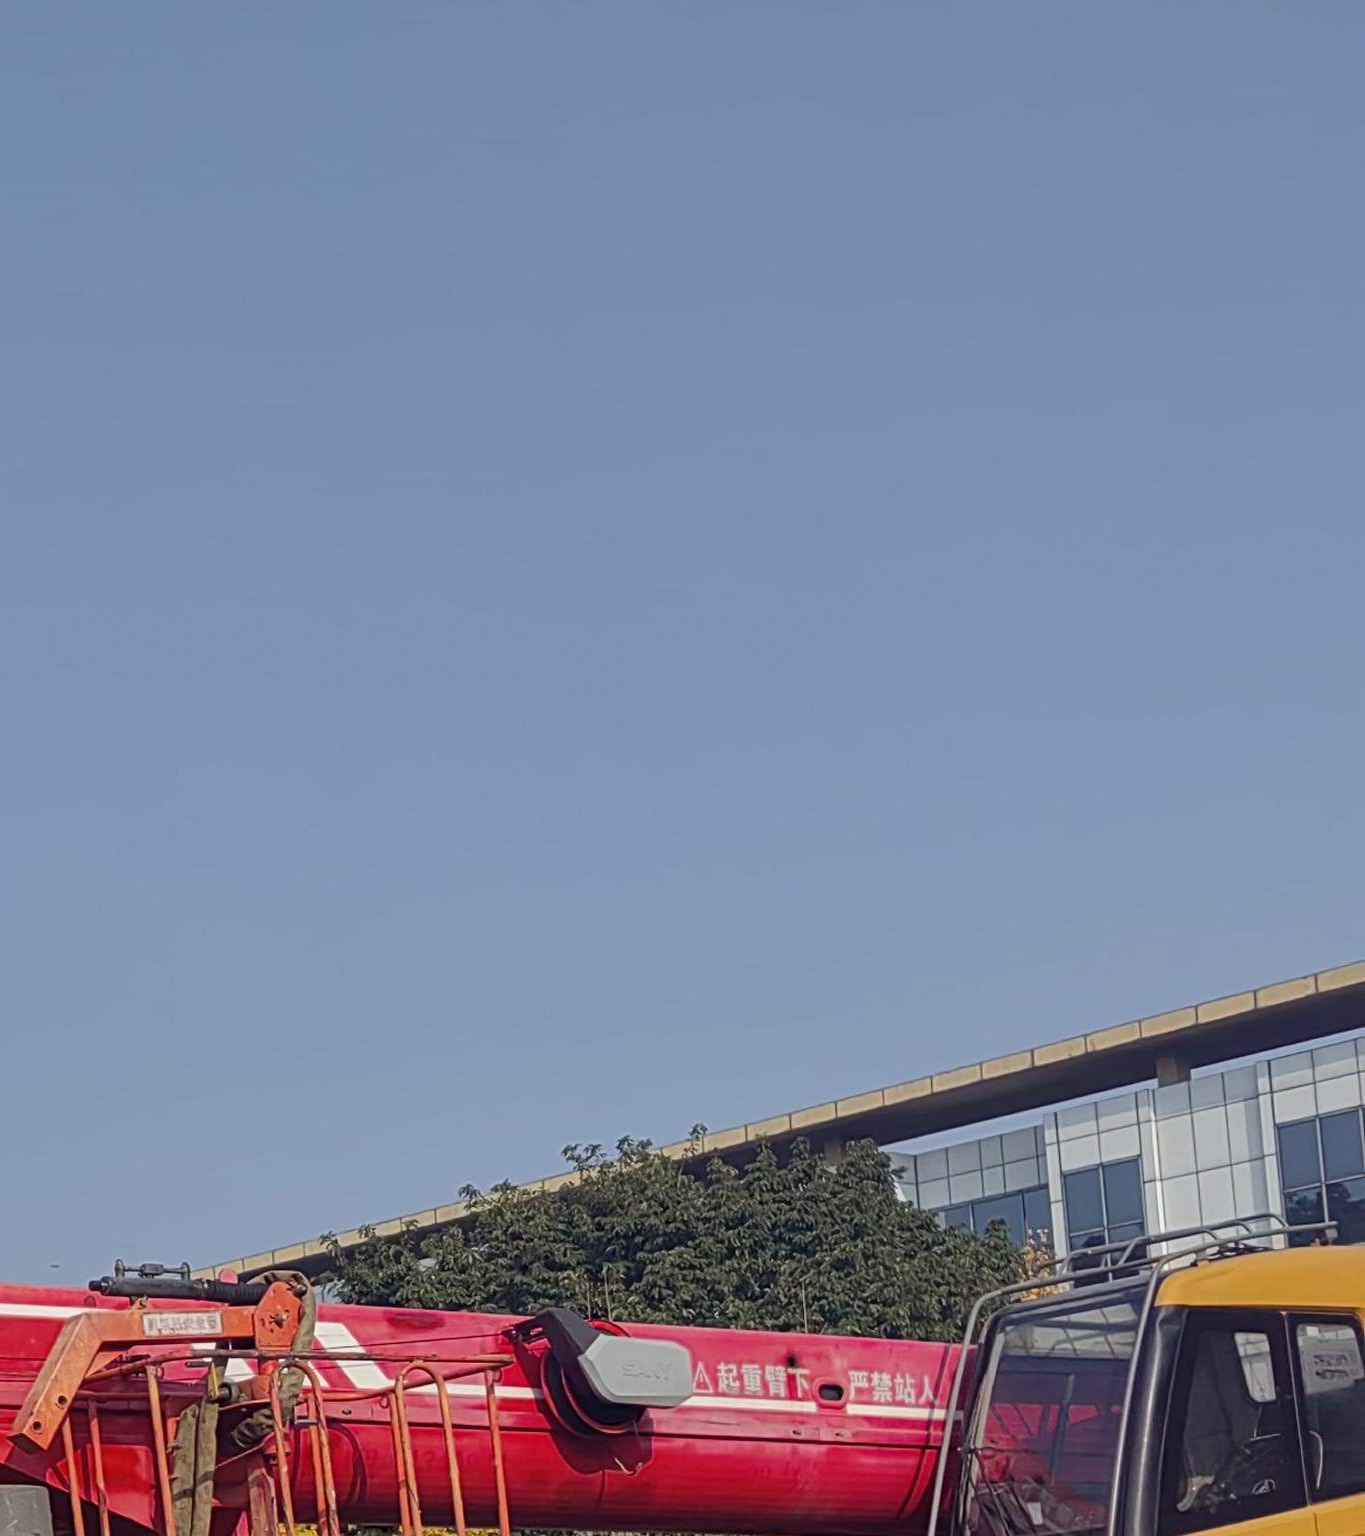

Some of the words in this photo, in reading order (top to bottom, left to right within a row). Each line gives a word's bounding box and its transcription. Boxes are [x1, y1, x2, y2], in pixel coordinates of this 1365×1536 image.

[717, 1362, 811, 1398] 起重臂下
[848, 1370, 938, 1404] 严禁站人
